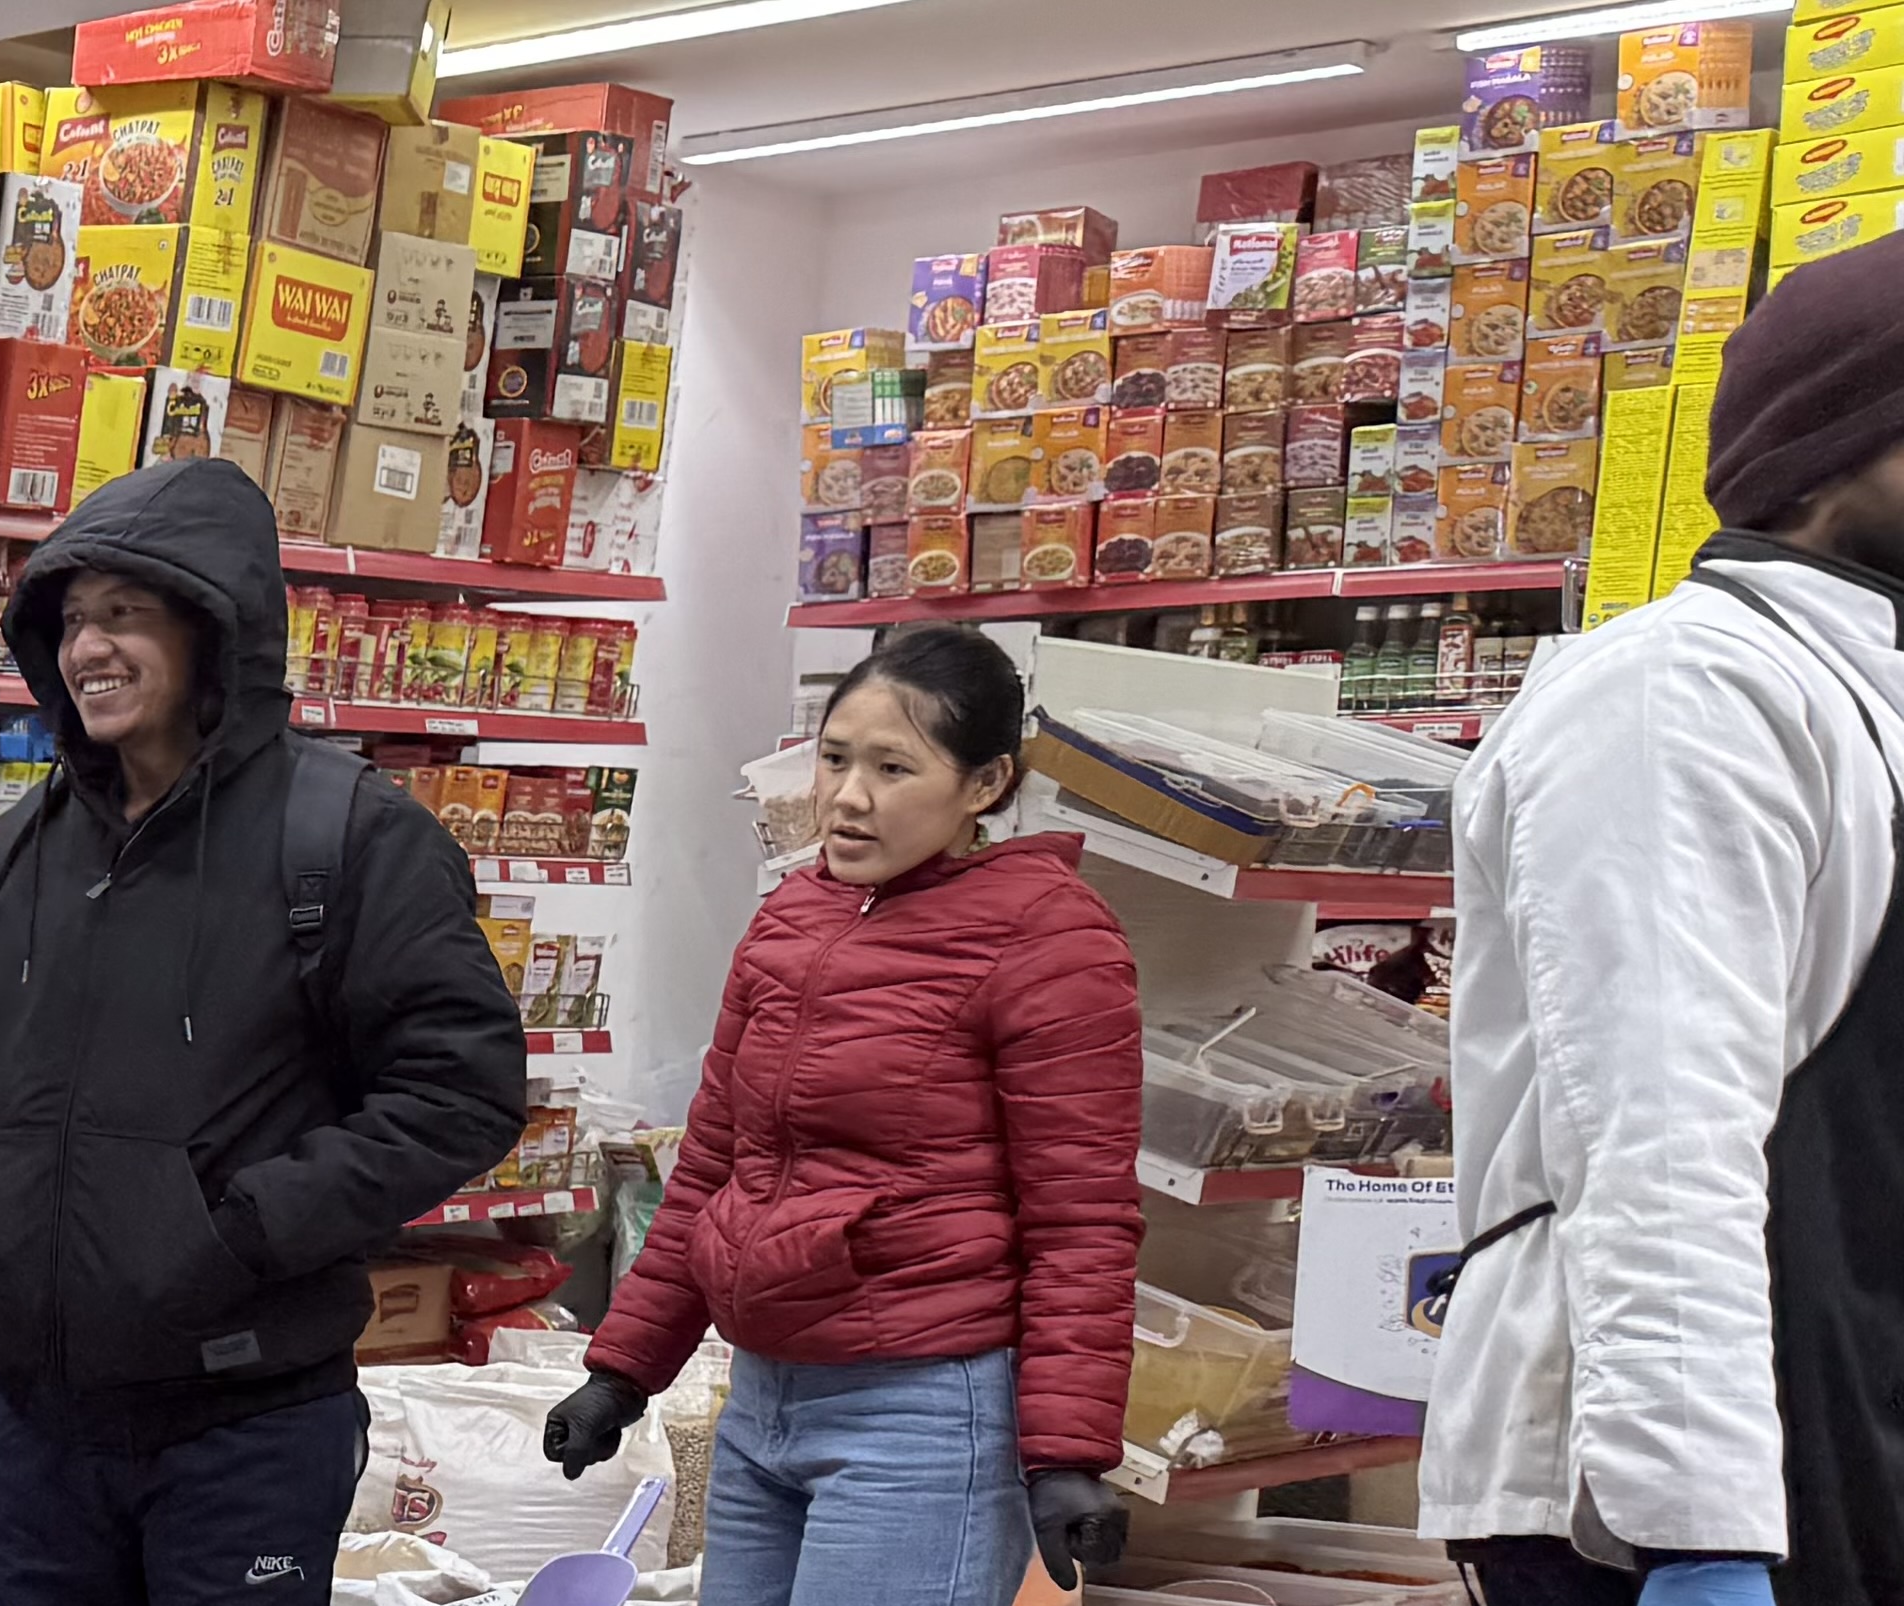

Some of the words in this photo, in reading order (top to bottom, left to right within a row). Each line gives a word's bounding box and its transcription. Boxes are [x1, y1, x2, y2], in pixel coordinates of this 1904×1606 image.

[1233, 234, 1279, 251] National
[278, 283, 312, 314] WAI
[315, 293, 349, 323] WAI
[1326, 1179, 1355, 1193] The
[1359, 1179, 1407, 1194] Home
[1412, 1178, 1433, 1194] Of
[254, 1555, 294, 1571] NIKE
